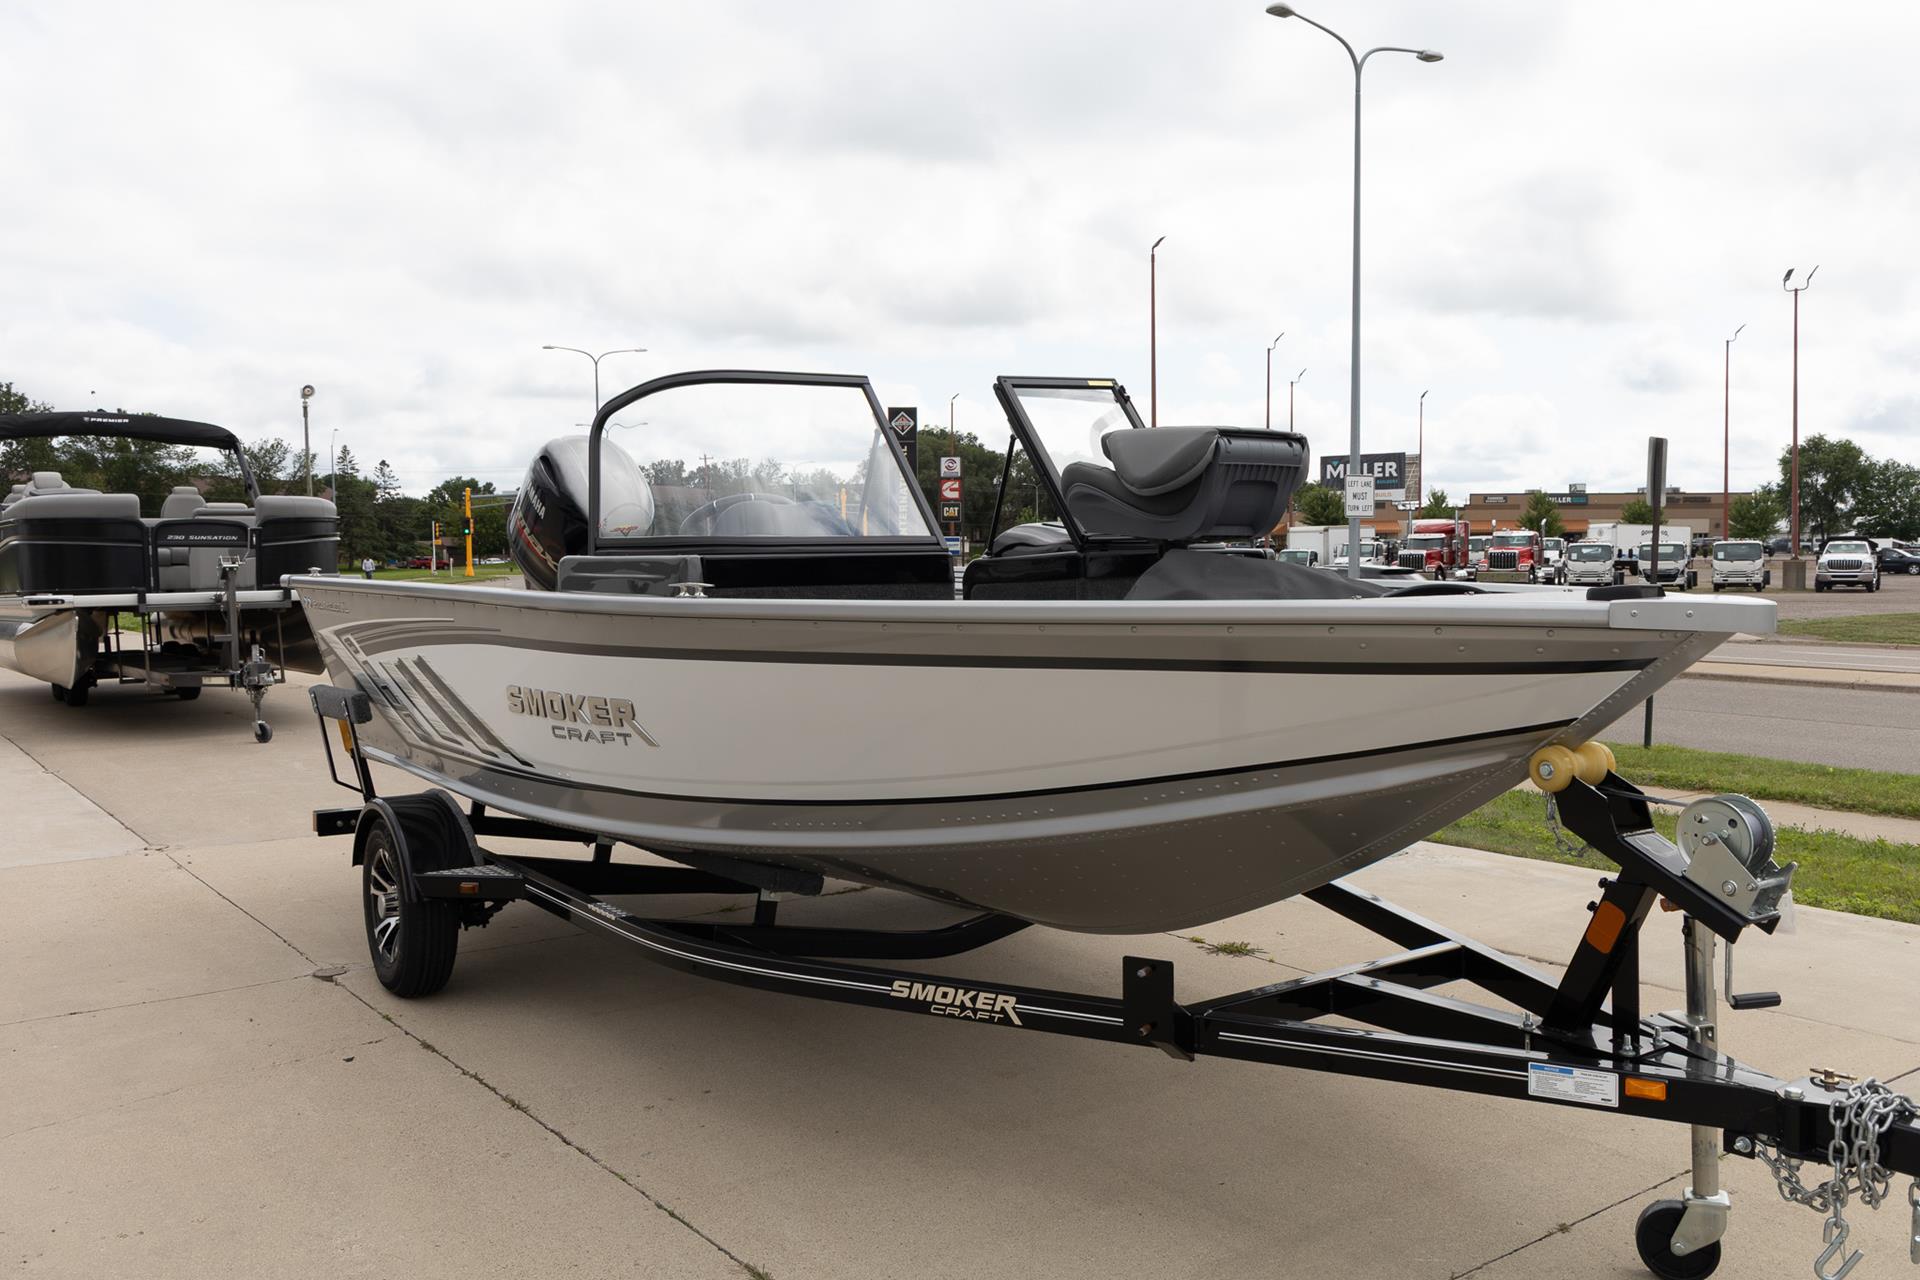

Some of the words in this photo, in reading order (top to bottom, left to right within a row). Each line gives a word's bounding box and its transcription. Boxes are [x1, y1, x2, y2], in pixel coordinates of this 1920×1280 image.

[1326, 461, 1398, 479] MILER
[1347, 480, 1359, 488] LEFT
[1360, 480, 1372, 488] LANE
[526, 479, 546, 520] AMAHA
[1352, 492, 1368, 500] MUST
[943, 507, 959, 517] CAT
[506, 684, 660, 747] SMOKER
[551, 725, 632, 746] CRAFT
[890, 980, 1023, 1026] SMOKER
[930, 1004, 1004, 1023] CRAFT
